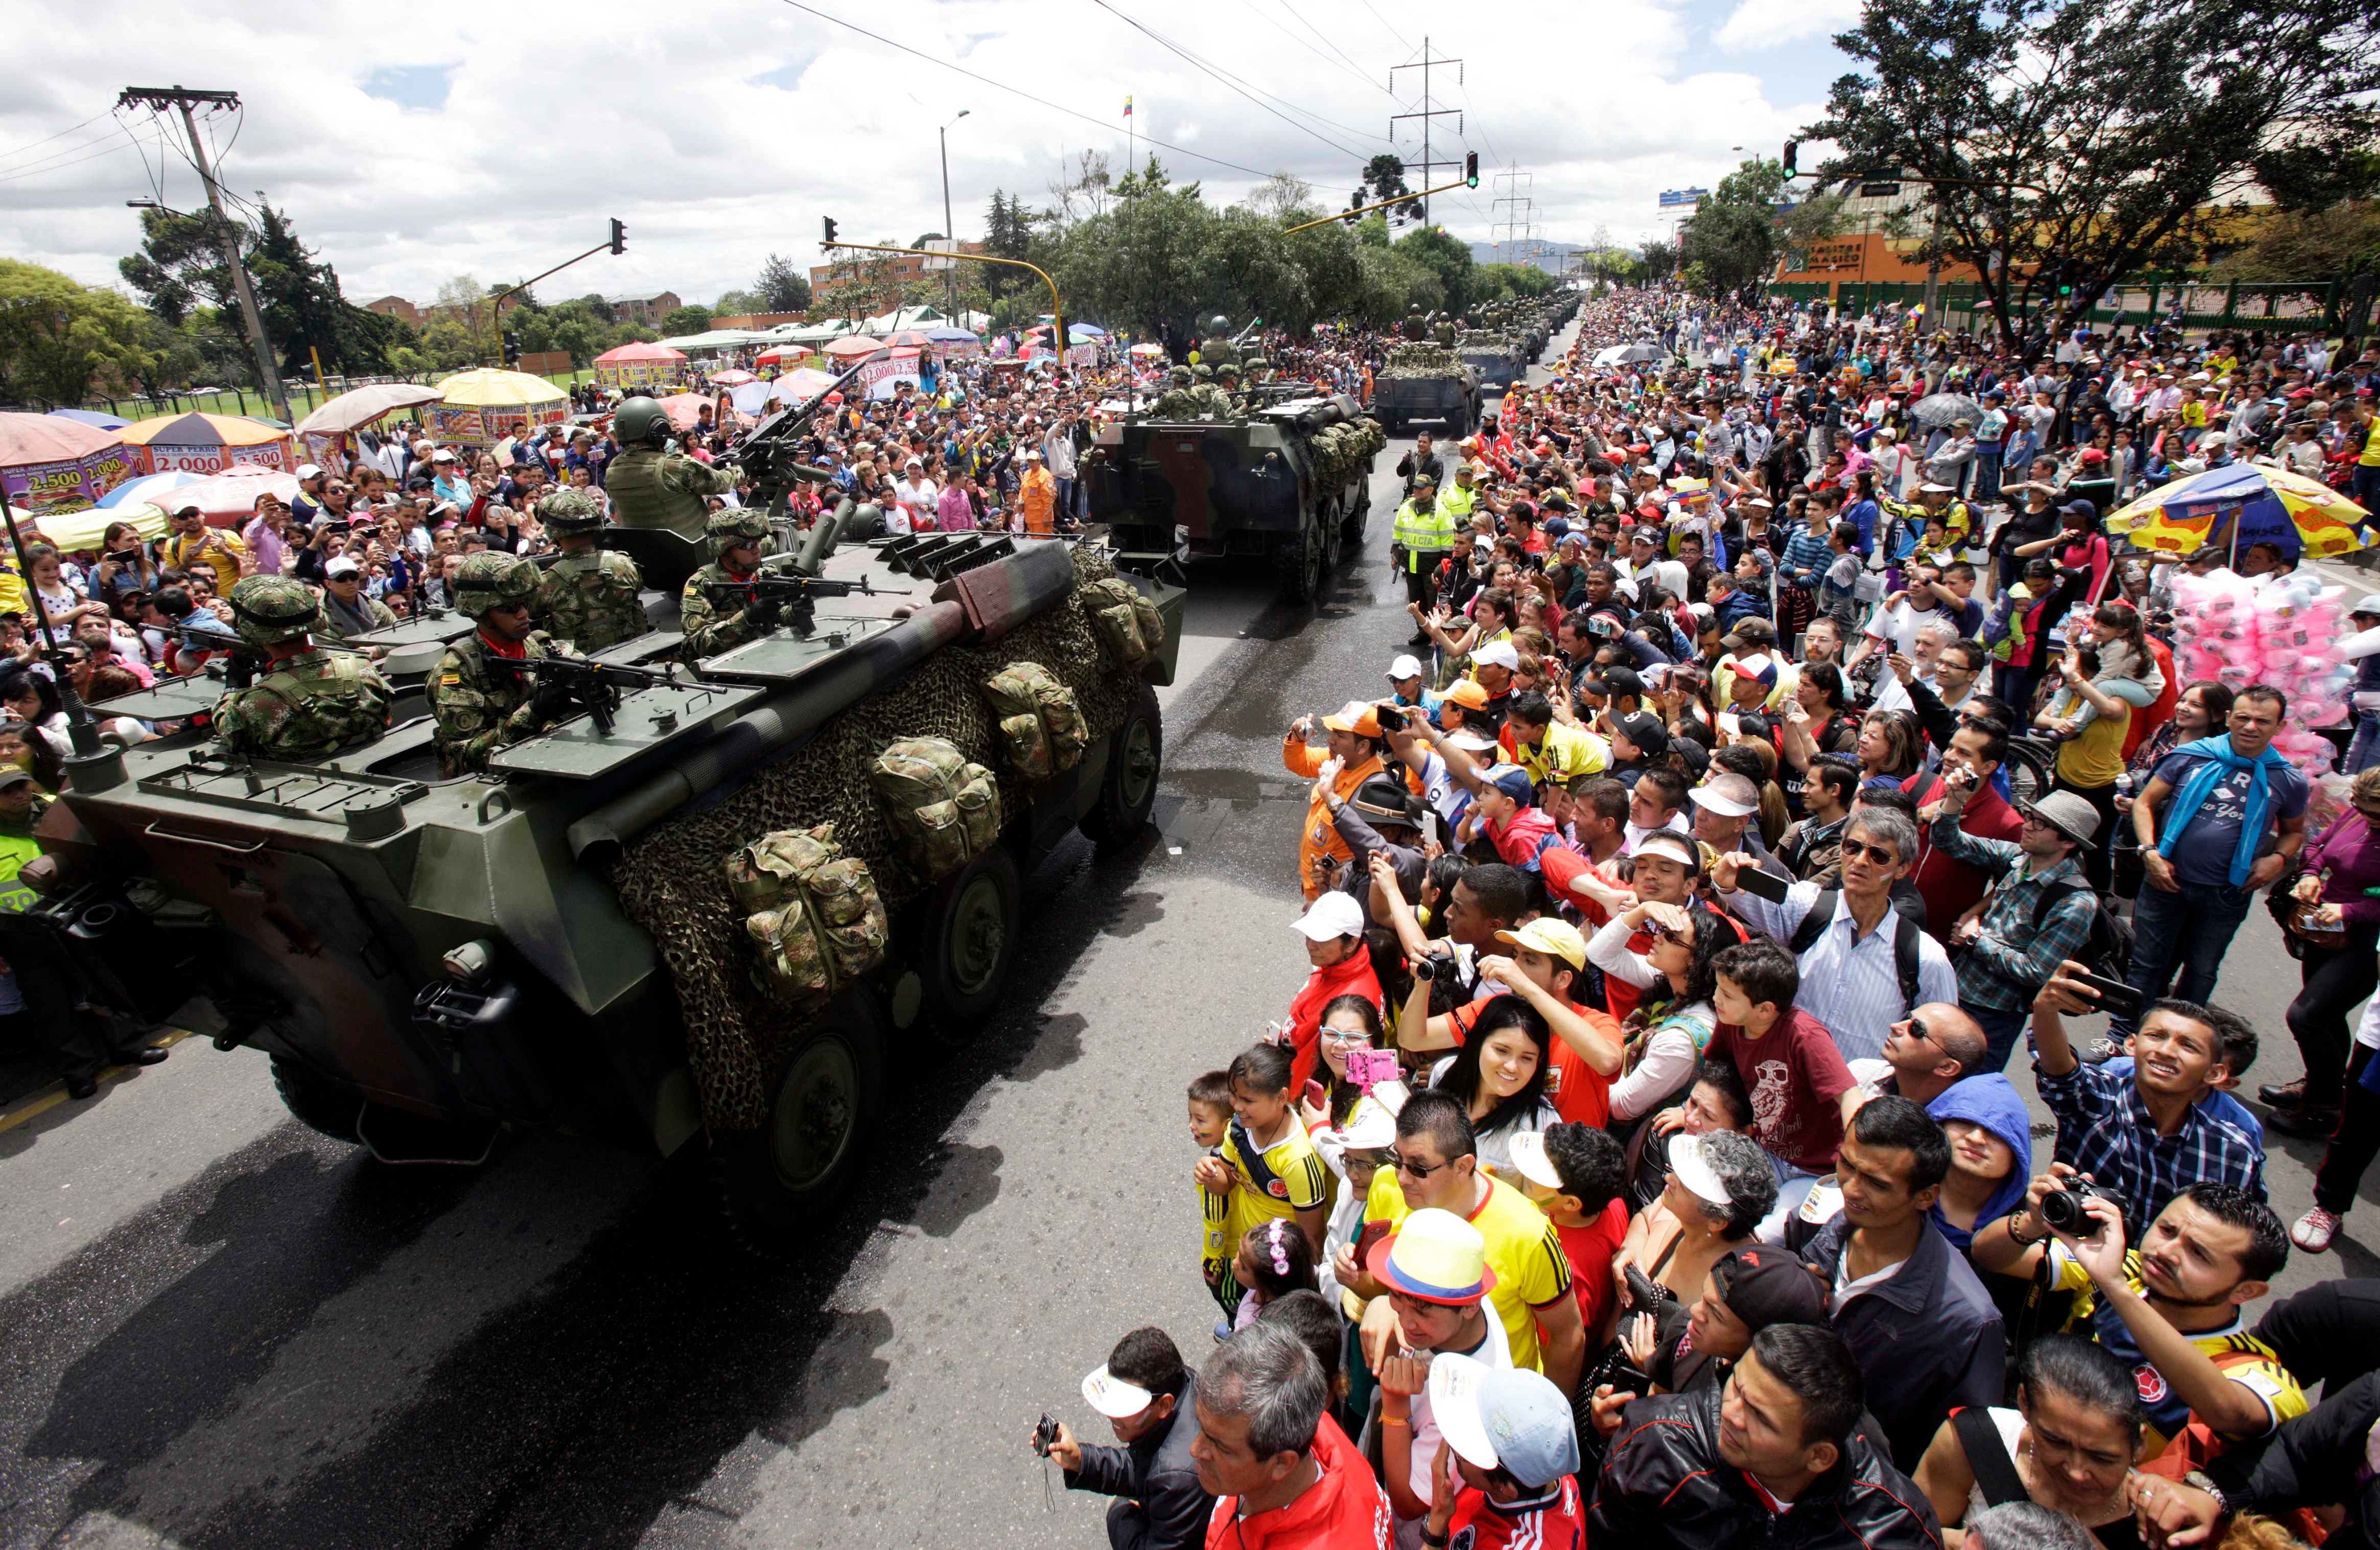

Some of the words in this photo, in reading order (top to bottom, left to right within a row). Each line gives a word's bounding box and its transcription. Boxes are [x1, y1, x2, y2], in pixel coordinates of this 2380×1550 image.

[86, 457, 122, 481] 2.000
[156, 457, 221, 471] 2.000
[28, 471, 83, 491] 2.500
